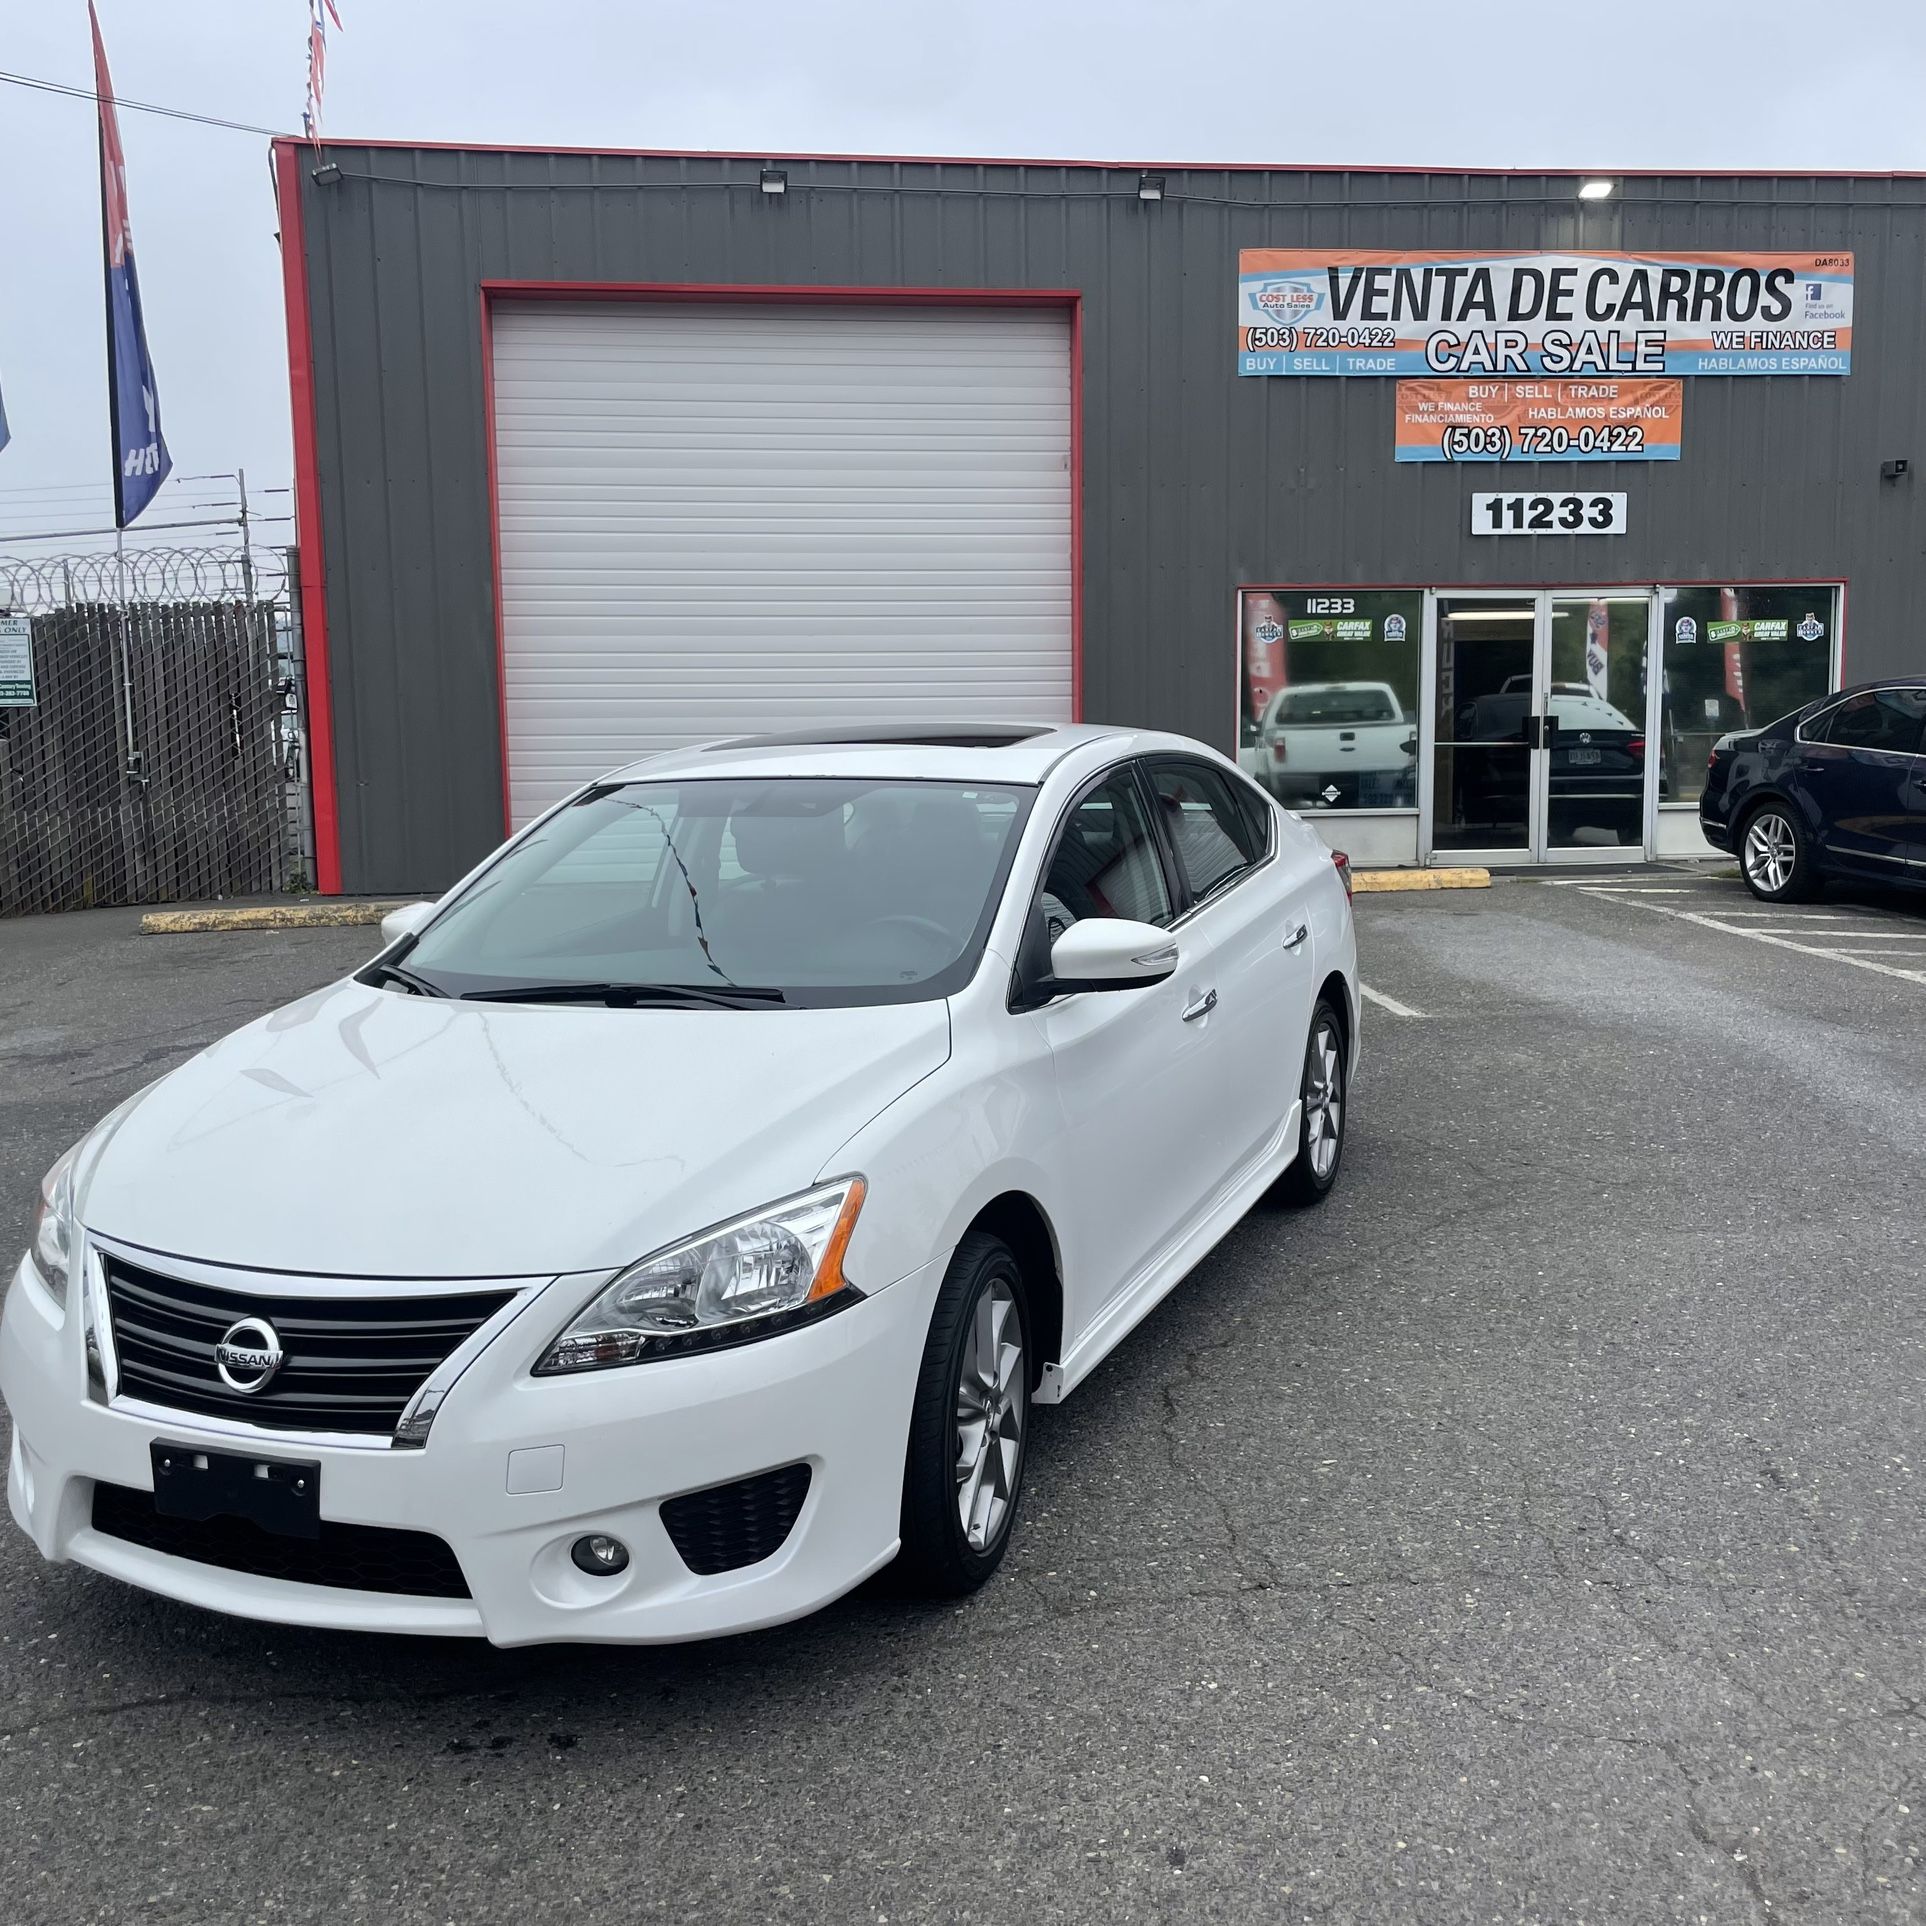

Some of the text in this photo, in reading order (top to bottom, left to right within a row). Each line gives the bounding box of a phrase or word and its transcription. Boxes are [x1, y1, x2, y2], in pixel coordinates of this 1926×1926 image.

[1814, 258, 1850, 267] DA8033
[1259, 294, 1314, 303] COST LESS
[1327, 266, 1795, 323] VENTA DE CARROS
[1804, 310, 1846, 320] Facebook
[1245, 326, 1396, 352] (503) 720-0422
[1711, 330, 1837, 350] WE FINANCE
[1425, 329, 1667, 374] CAR SALE
[1246, 358, 1396, 371] BUY SELL TRADE
[1698, 354, 1847, 371] HABLAMOS ESPAÑOL
[1468, 385, 1619, 398] BUY SELL TRADE
[1417, 402, 1483, 412] WE FINANCE
[1528, 404, 1670, 419] HABLAMOS ESPAÑOL
[1405, 414, 1495, 424] FINANCIAMIENTO
[1442, 425, 1644, 461] (503) 720-0422
[1485, 496, 1615, 530] 11233
[1306, 598, 1355, 614] 11233
[1337, 621, 1371, 631] CARFAX
[1754, 621, 1787, 631] CARFAX
[218, 1346, 272, 1367] NISSAN
